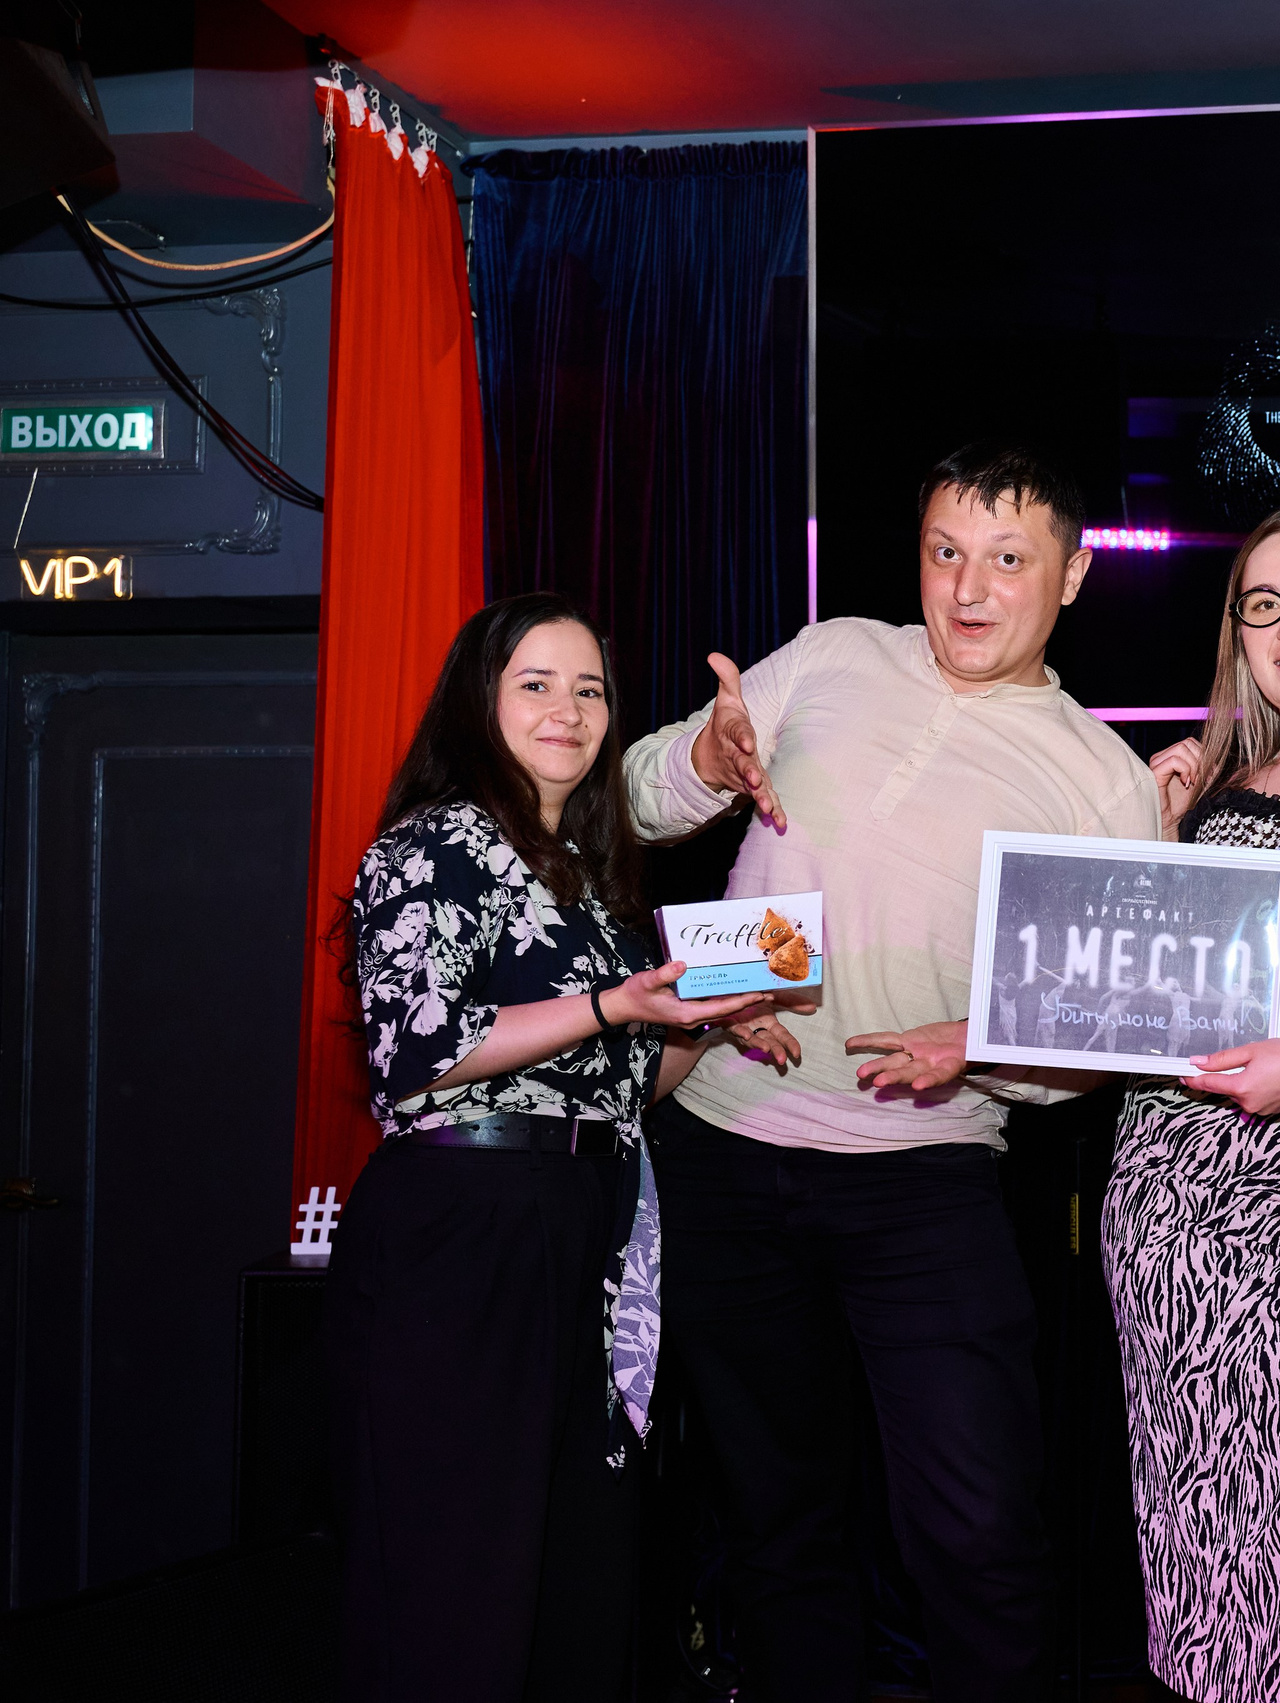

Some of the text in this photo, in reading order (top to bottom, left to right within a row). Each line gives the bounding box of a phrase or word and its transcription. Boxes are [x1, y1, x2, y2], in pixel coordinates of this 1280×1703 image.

[10, 411, 150, 450] ВЫХОД
[20, 556, 97, 599] VIP
[1085, 905, 1195, 923] АРТЕФАКТ
[679, 920, 788, 948] Truffle
[1018, 923, 1252, 998] 1 МЕСТО
